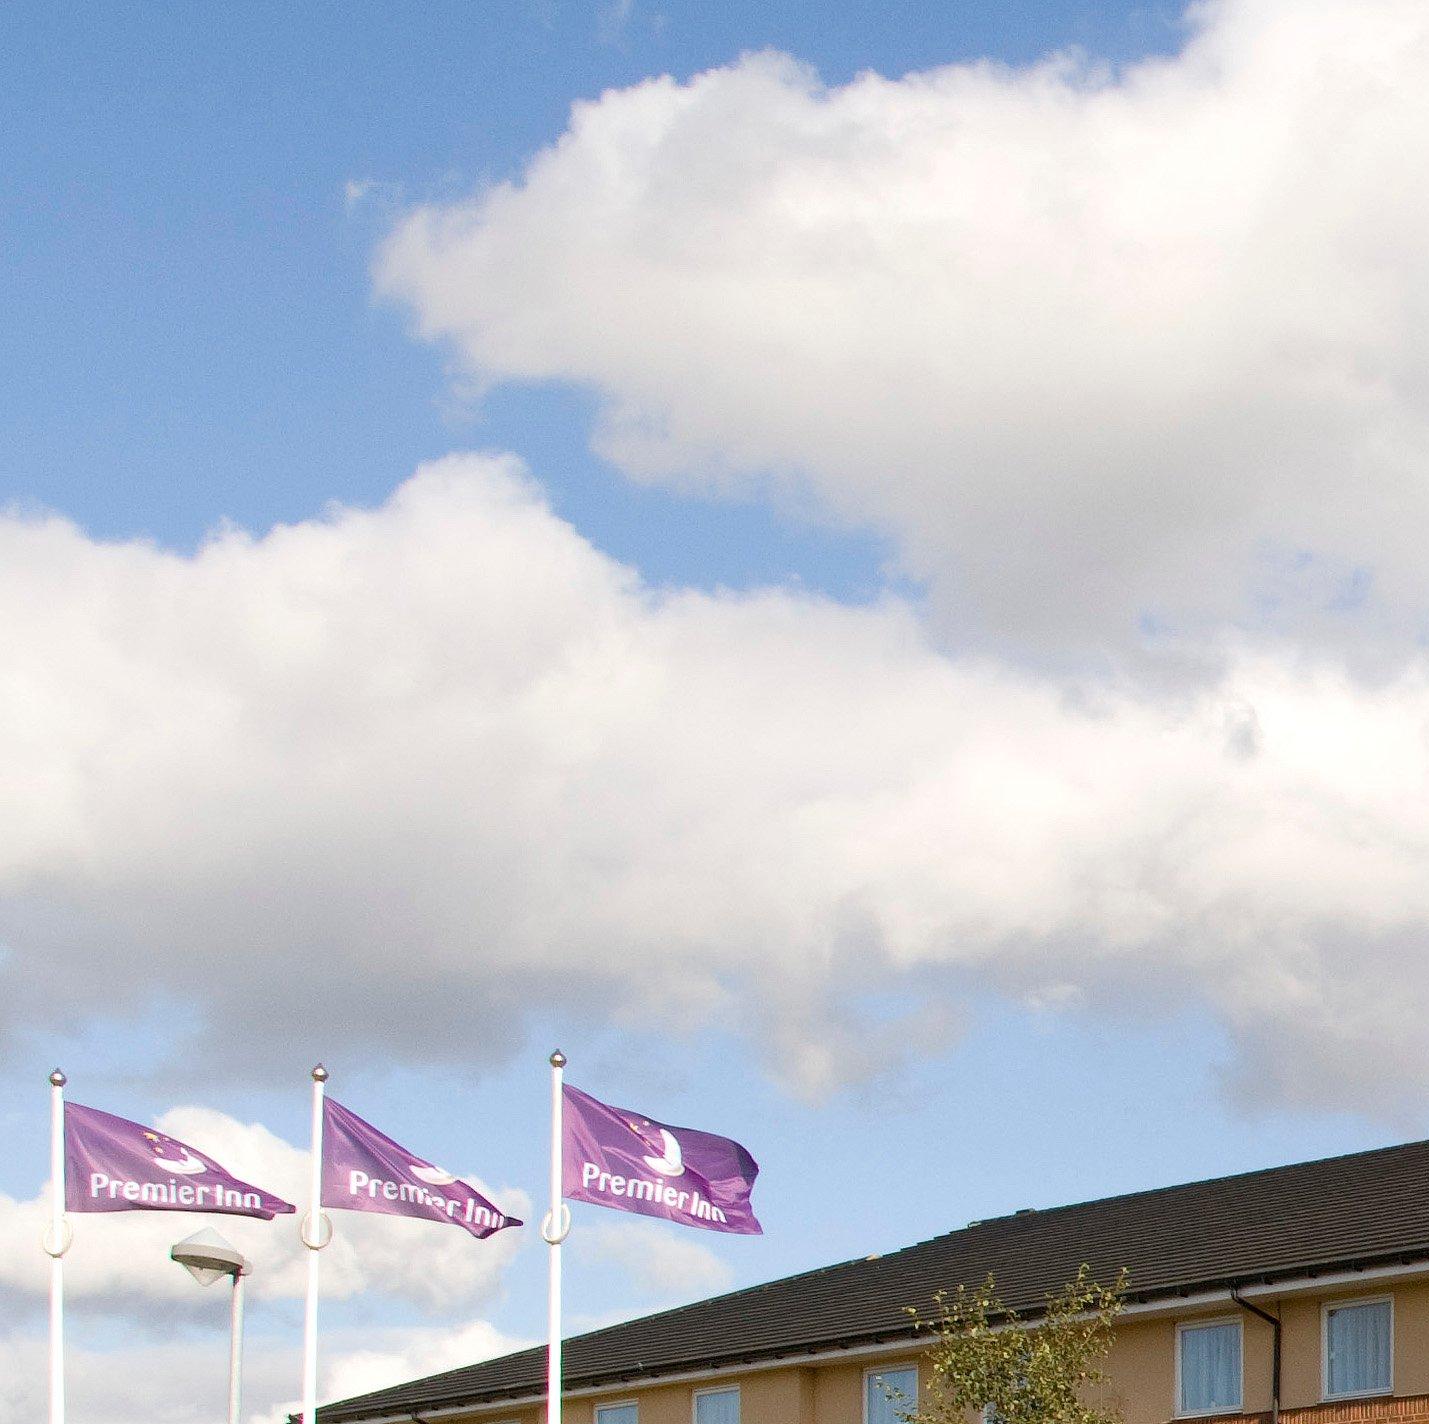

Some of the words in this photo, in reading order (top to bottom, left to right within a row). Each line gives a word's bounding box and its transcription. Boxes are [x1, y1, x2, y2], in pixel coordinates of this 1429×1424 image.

[90, 1172, 210, 1205] Premier
[214, 1184, 262, 1209] Inn
[581, 1162, 690, 1210] Premier
[690, 1191, 728, 1224] Inn
